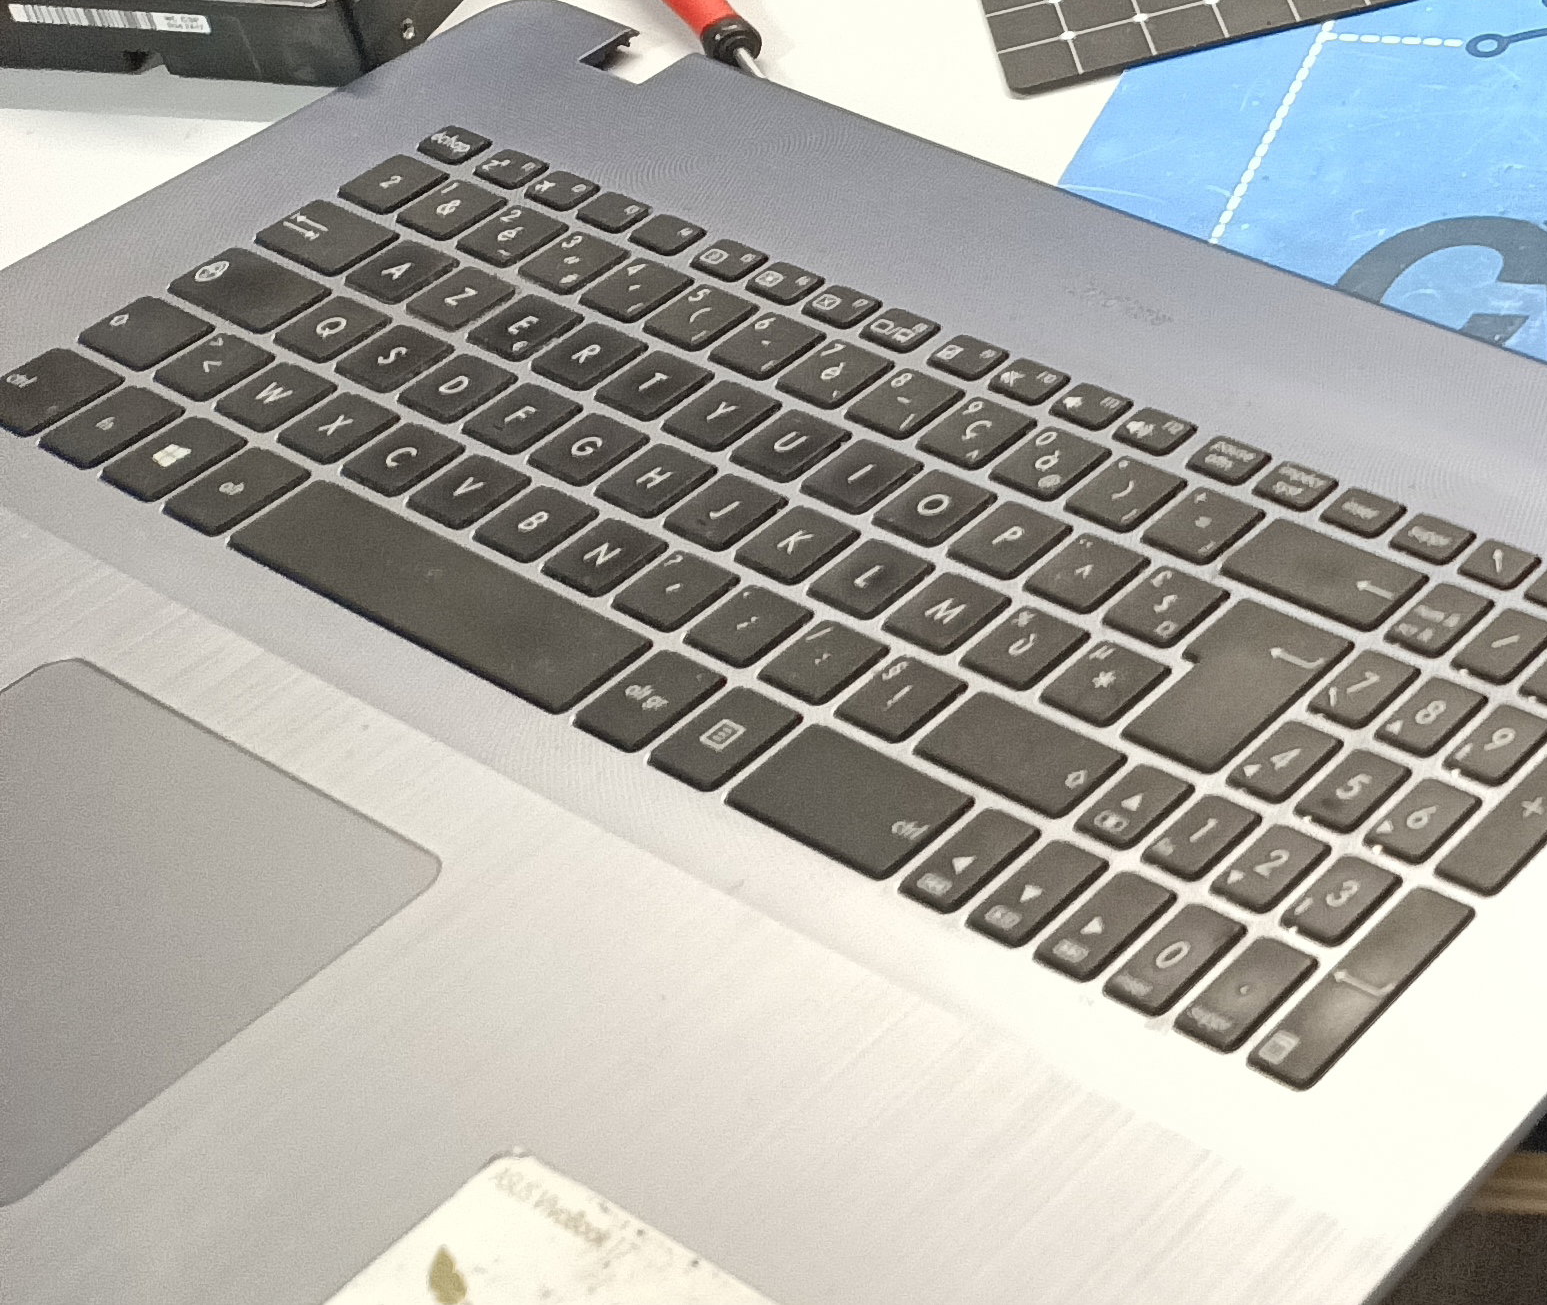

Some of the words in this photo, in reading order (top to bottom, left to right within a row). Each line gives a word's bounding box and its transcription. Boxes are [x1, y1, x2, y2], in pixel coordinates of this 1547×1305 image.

[500, 209, 522, 223] 2
[561, 235, 583, 249] 3
[380, 262, 415, 281] A
[444, 287, 478, 306] Z
[688, 288, 712, 302] 5
[315, 316, 347, 339] Q
[507, 315, 540, 336] E
[754, 317, 776, 331] 6
[377, 346, 408, 366] S
[571, 344, 602, 364] R
[821, 343, 847, 357] 7
[438, 375, 469, 395] D
[638, 372, 669, 393] T
[890, 372, 913, 388] 8
[254, 381, 294, 404] W
[504, 405, 537, 424] F
[706, 401, 740, 423] Y
[962, 400, 984, 415] 9
[317, 413, 354, 437] X
[570, 435, 603, 457] G
[773, 430, 810, 453] U
[1034, 430, 1058, 446] 0
[385, 446, 418, 468] C
[453, 476, 485, 497] V
[635, 466, 674, 490] H
[708, 499, 742, 521] J
[916, 493, 951, 517] O
[517, 510, 550, 532] B
[776, 529, 815, 555] K
[991, 524, 1026, 545] P
[582, 542, 622, 567] N
[854, 564, 884, 589] L
[923, 597, 968, 625] M
[1346, 670, 1380, 694] 7
[1414, 699, 1448, 725] 8
[1483, 727, 1517, 751] 9
[1269, 747, 1302, 771] 4
[1335, 773, 1373, 800] 5
[1405, 804, 1438, 830] 6
[1521, 796, 1545, 818] +
[1188, 817, 1219, 843] 1
[1254, 848, 1291, 877] 2
[1325, 879, 1361, 907] 3
[1154, 939, 1193, 970] 0
